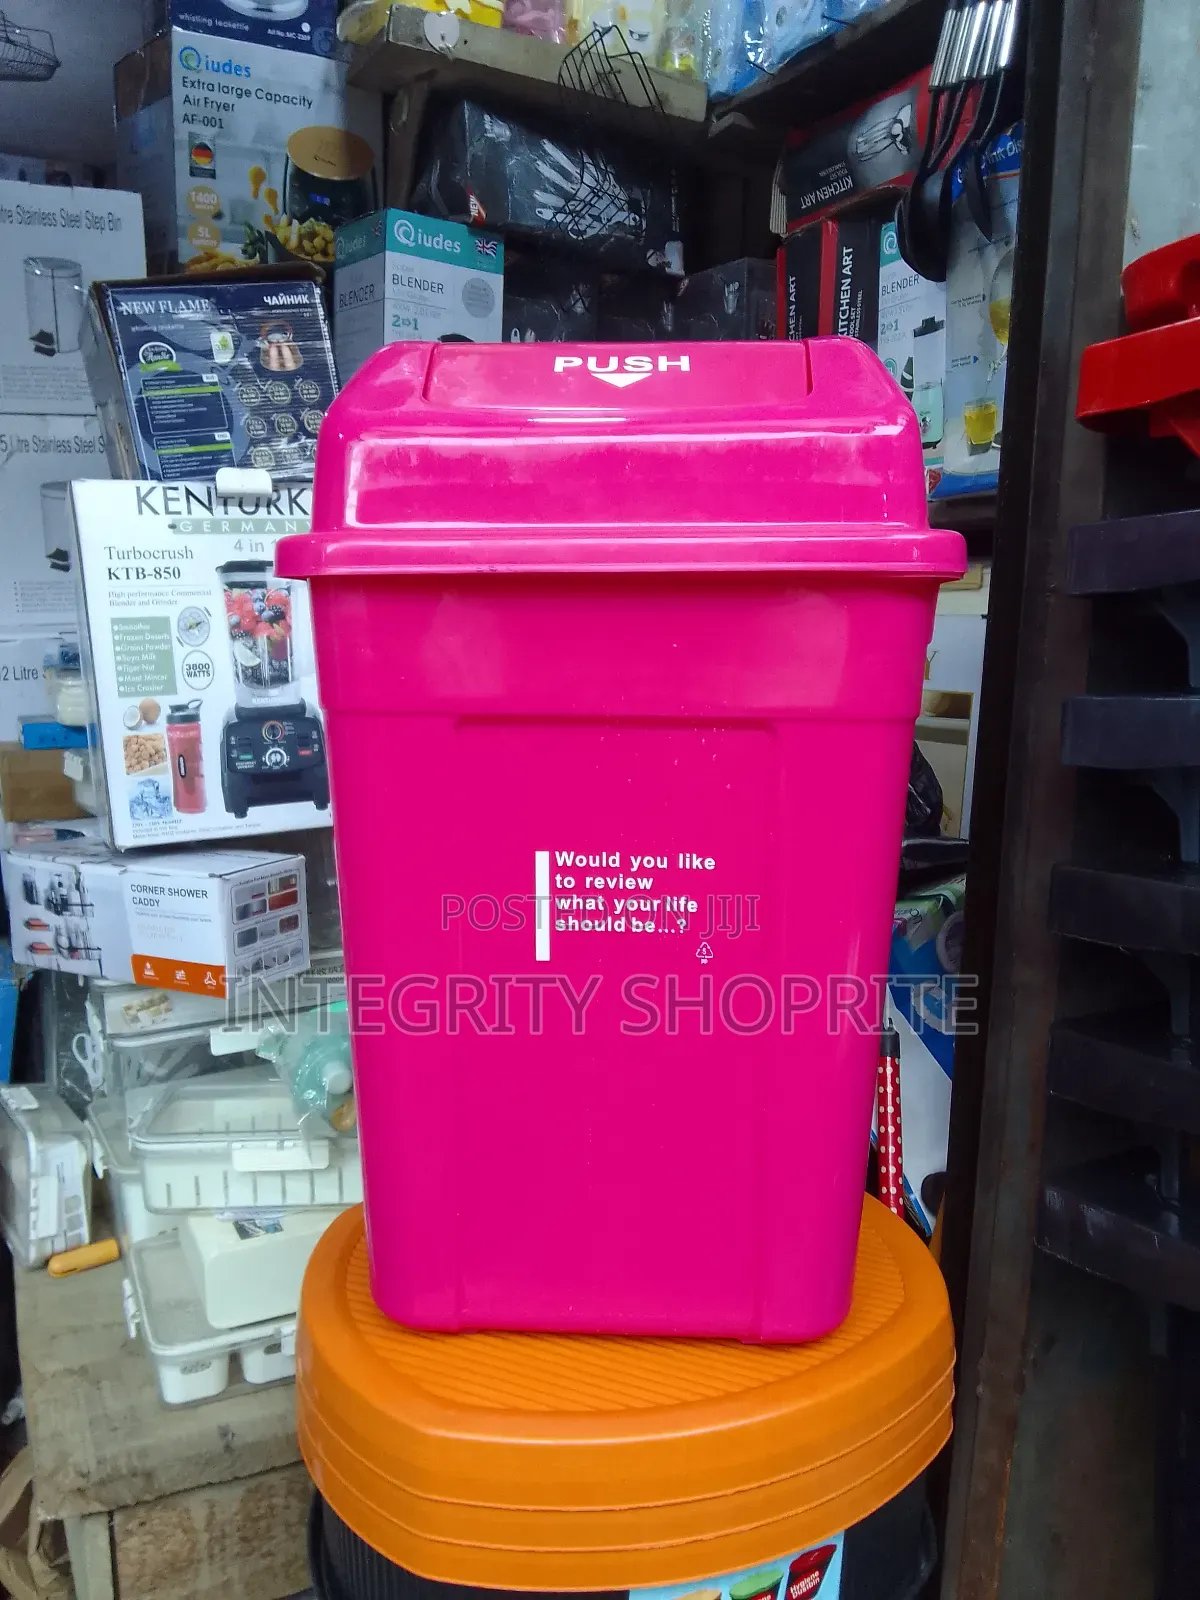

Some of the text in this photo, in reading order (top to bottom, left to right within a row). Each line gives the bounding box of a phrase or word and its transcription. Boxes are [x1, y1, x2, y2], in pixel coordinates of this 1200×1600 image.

[179, 46, 251, 78] Qiudes
[182, 75, 313, 110] Extra large Capacity
[183, 94, 235, 112] Air Fryer
[182, 112, 224, 129] AF-001
[800, 175, 853, 209] KITCHEN ART
[16, 203, 58, 228] Stainless
[60, 207, 82, 229] Steel
[84, 209, 106, 235] Step
[107, 211, 122, 232] Bin
[394, 219, 461, 253] Qiudes
[842, 246, 853, 275] ART
[392, 273, 444, 294] BLENDER
[881, 274, 920, 296] BLENDER
[263, 292, 310, 306] ЧАЙНИК
[340, 283, 375, 308] BLENDER
[119, 298, 211, 315] NEW FLAME
[553, 355, 691, 373] PUSH
[9, 433, 30, 453] Litre
[32, 434, 72, 453] Stainless
[73, 434, 96, 454] Steel
[103, 545, 194, 561] Turbocrush
[234, 539, 243, 552] 4
[249, 539, 265, 553] in
[107, 566, 181, 582] KTB-850
[127, 590, 170, 600] performance
[171, 588, 213, 597] Commercial
[109, 599, 136, 607] Blender
[141, 652, 156, 660] Milk
[12, 665, 39, 681] Litre
[141, 663, 155, 671] Nut
[185, 662, 211, 671] 3800
[186, 670, 211, 678] WATTS
[554, 850, 716, 872] Would you like
[555, 873, 654, 890] to review
[130, 884, 209, 899] CORNER SHOWER
[132, 896, 160, 907] CADDY
[555, 894, 698, 915] what your life
[555, 915, 626, 932] should
[790, 1570, 820, 1593] Hygiene
[791, 1577, 820, 1599] Dustbin
